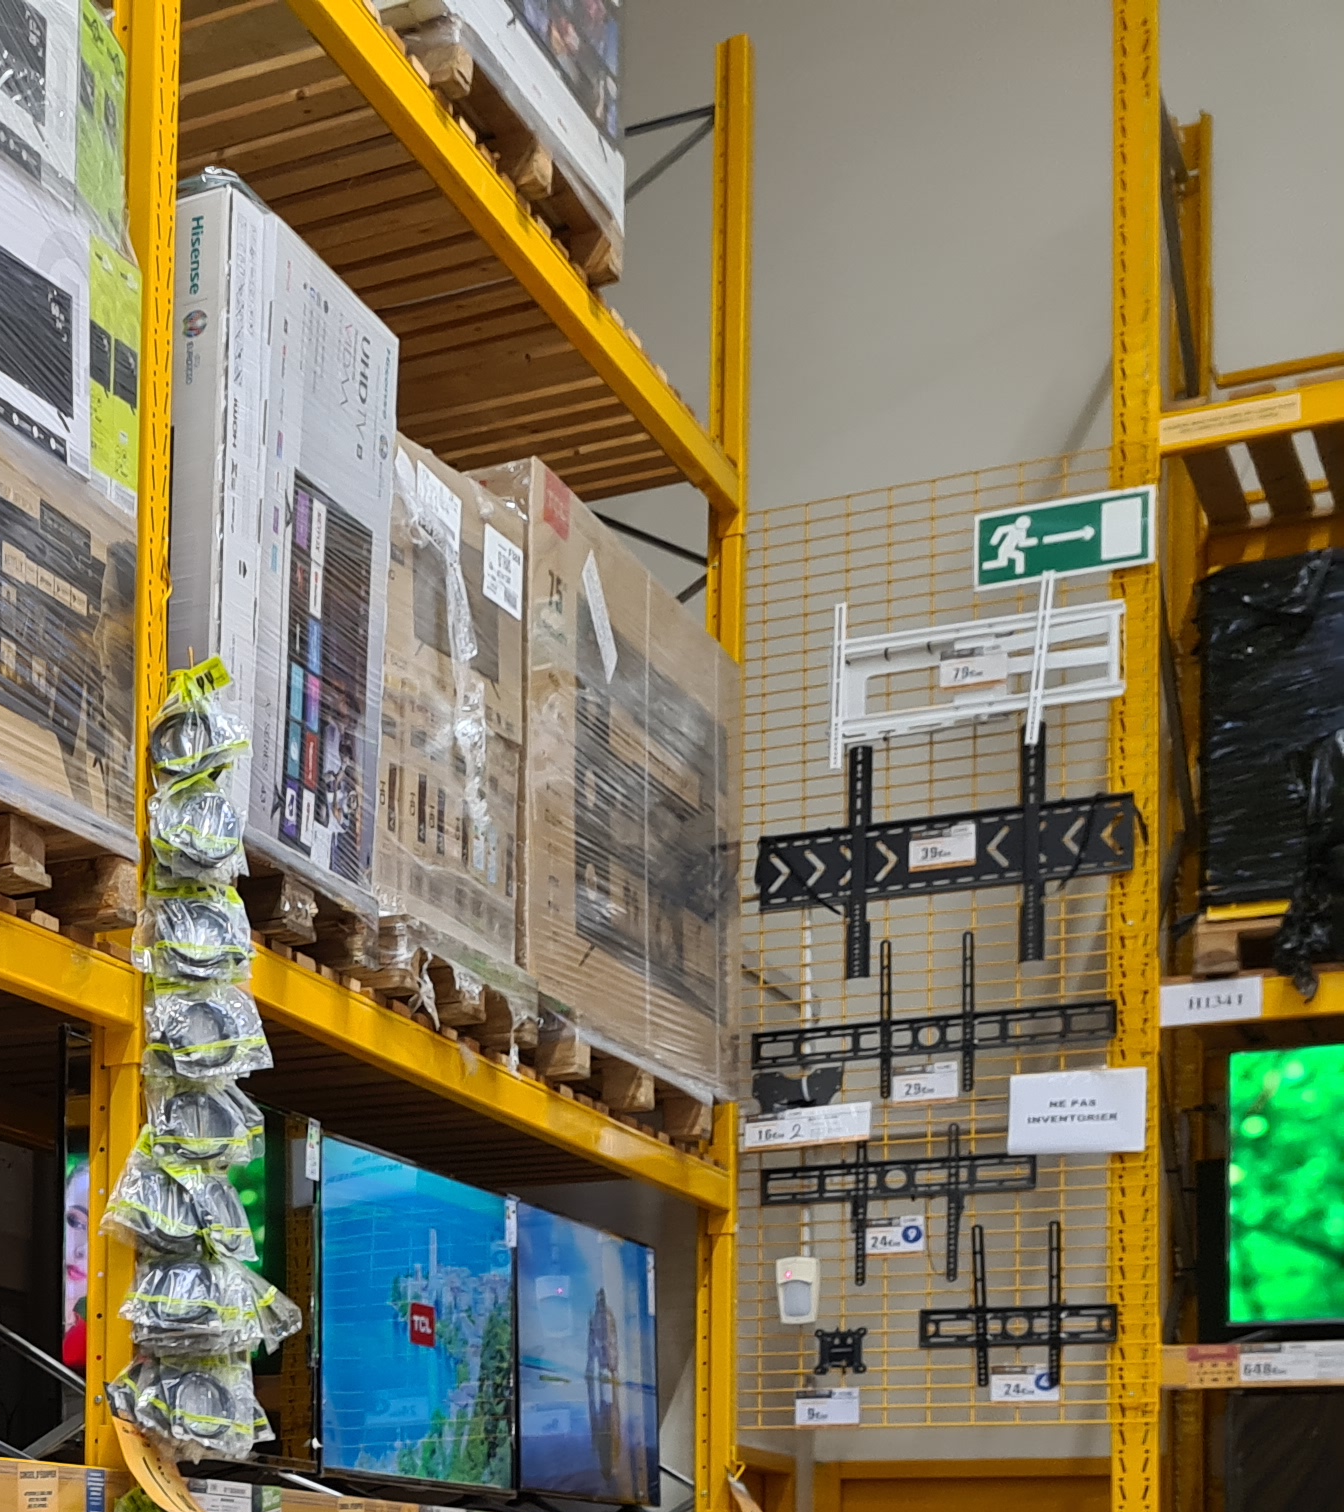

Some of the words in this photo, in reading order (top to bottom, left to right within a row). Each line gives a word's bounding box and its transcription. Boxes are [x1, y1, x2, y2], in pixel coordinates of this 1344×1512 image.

[190, 215, 204, 296] Hisense
[358, 336, 371, 405] UHD
[1028, 1111, 1118, 1125] INVENTORIER
[413, 1314, 432, 1335] TCL
